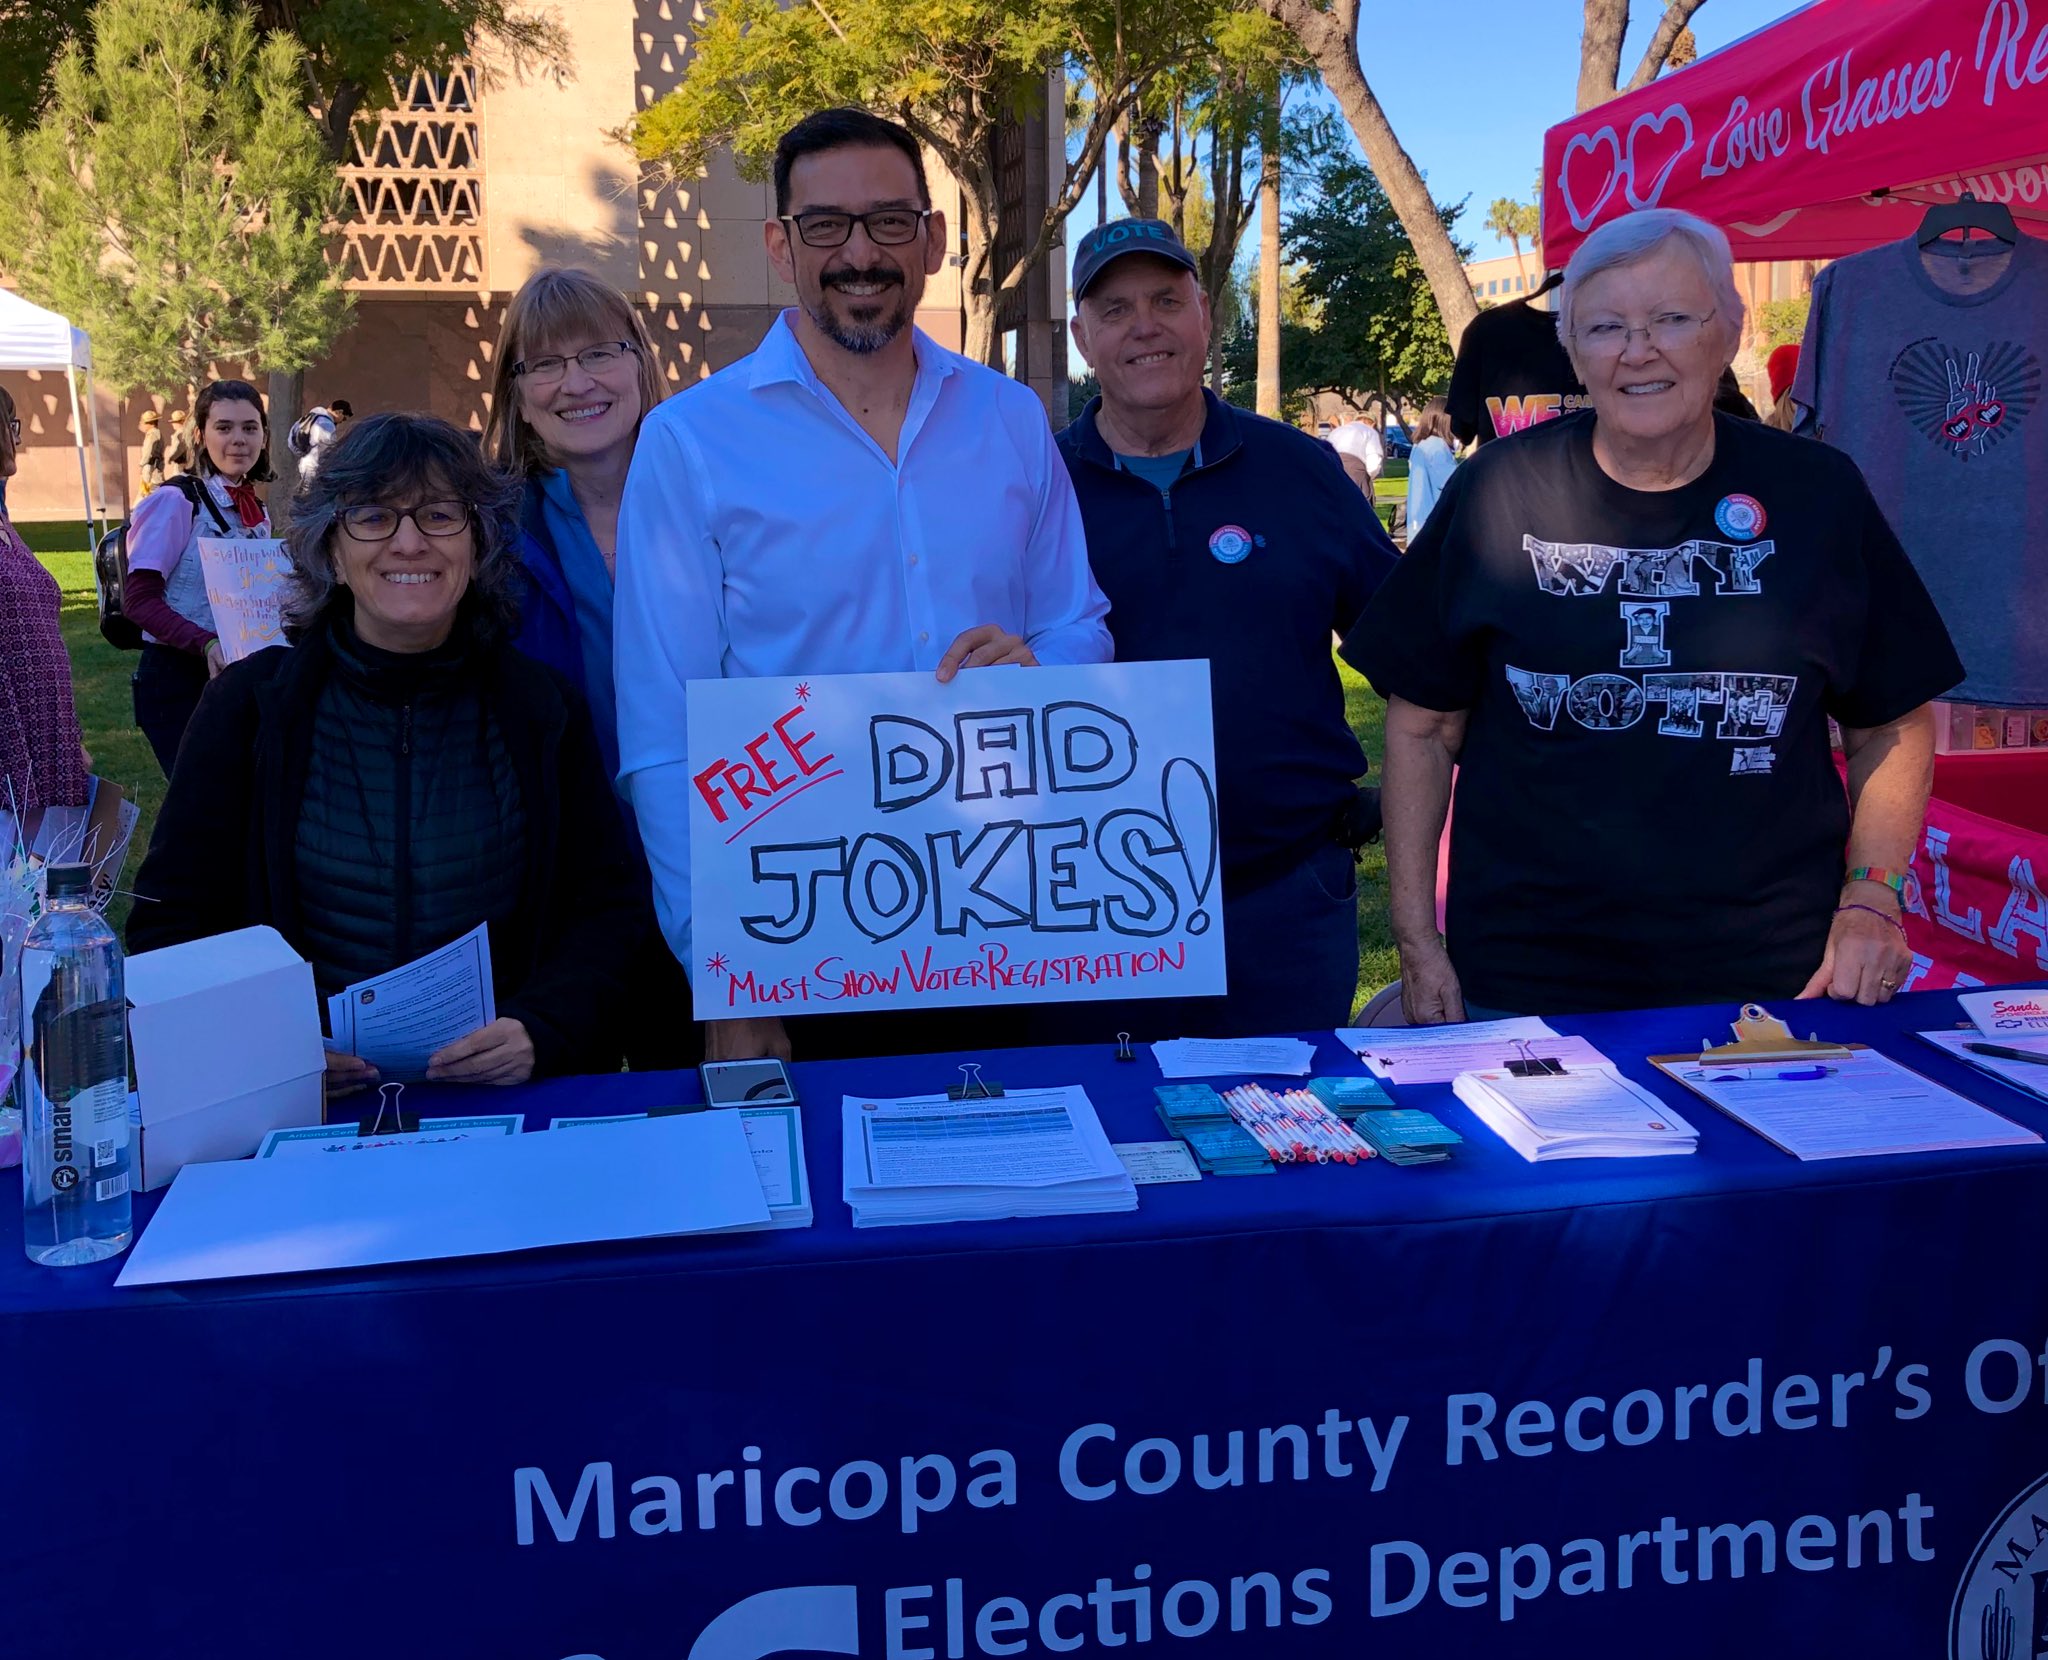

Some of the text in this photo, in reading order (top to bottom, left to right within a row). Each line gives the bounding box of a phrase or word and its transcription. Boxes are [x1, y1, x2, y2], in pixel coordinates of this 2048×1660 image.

[1700, 96, 1790, 179] Love
[1801, 48, 1962, 154] Glasses
[1092, 223, 1167, 253] VOTE
[1523, 533, 1775, 597] WHY
[1619, 601, 1672, 668] I
[1505, 664, 1798, 739] VOTE
[868, 701, 1139, 814] DAD
[740, 757, 1218, 945] JOKES!
[814, 956, 900, 1001] SHOW
[901, 946, 988, 993] VOTER
[979, 941, 1185, 991] REGISTRATION
[1993, 1001, 2042, 1013] Sands
[513, 1446, 1017, 1546] Maricopa
[1058, 1409, 1410, 1502] County
[1446, 1346, 1932, 1466] Recorder’s
[884, 1493, 1936, 1660] Elections Department
